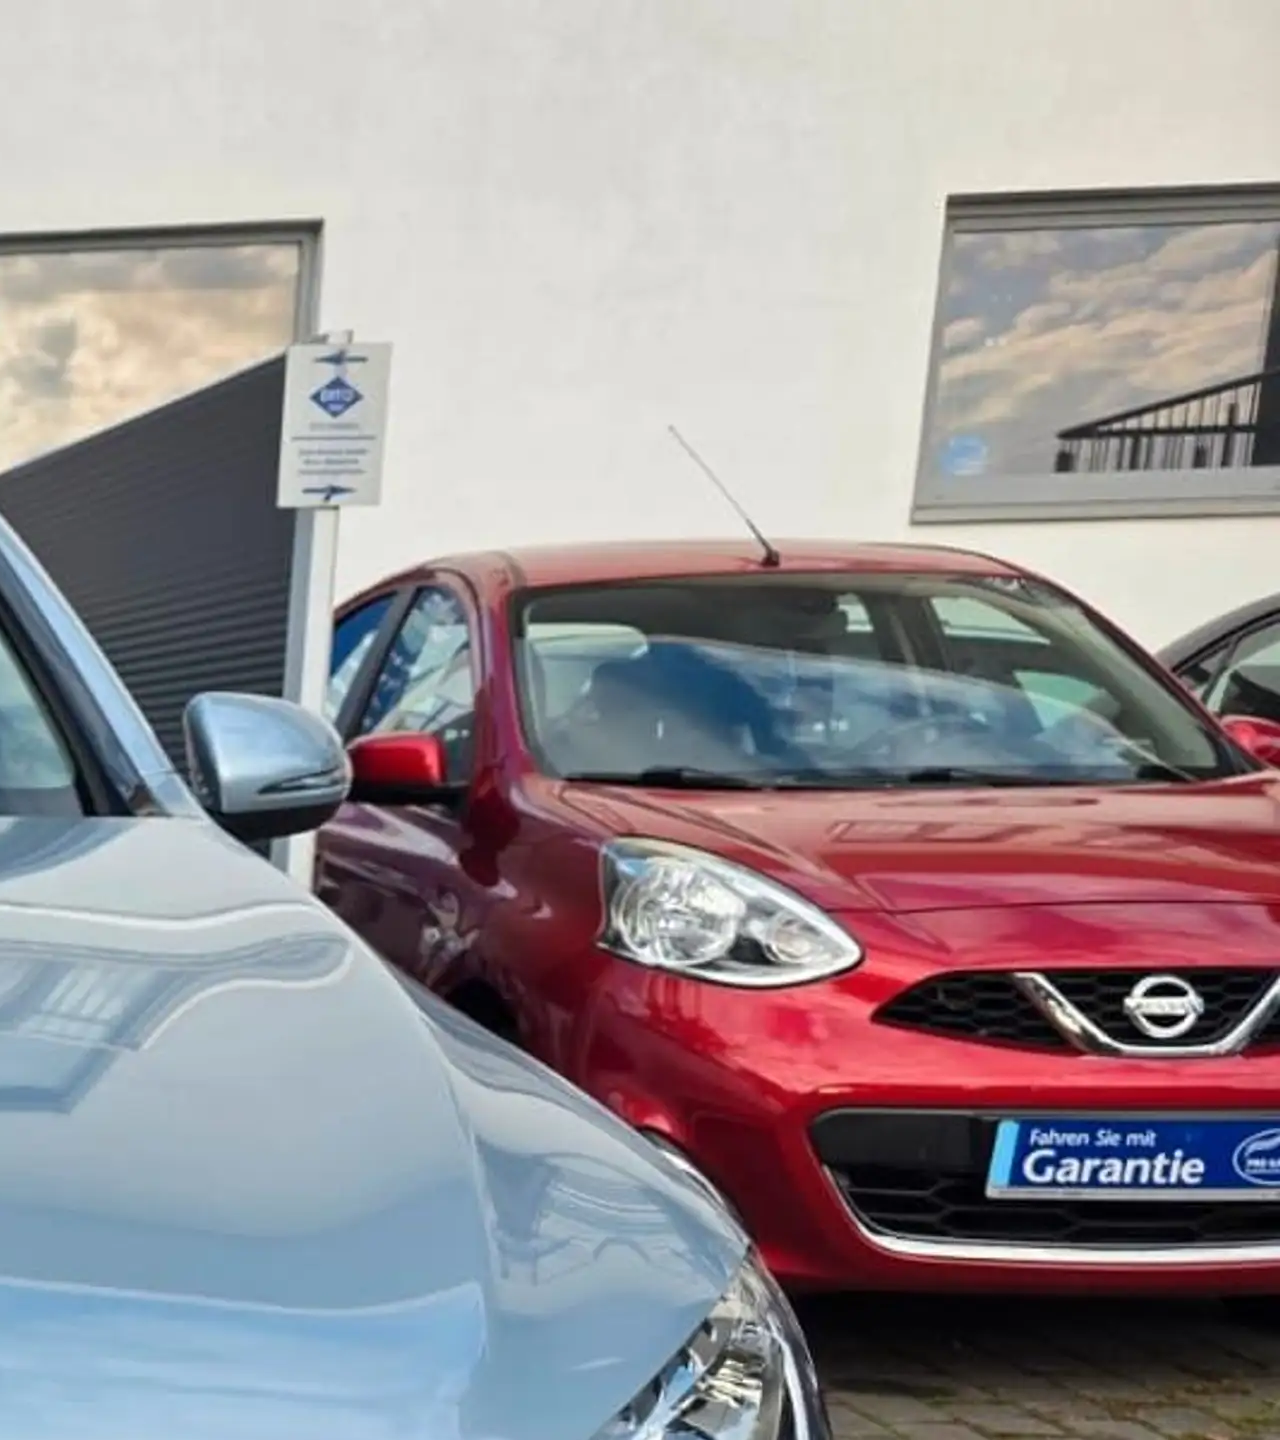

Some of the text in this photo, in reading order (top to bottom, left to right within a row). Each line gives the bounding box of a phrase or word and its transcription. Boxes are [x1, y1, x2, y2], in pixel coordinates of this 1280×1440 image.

[1030, 1129, 1157, 1147] Fahren Sie mit
[1023, 1149, 1205, 1185] Garantie
